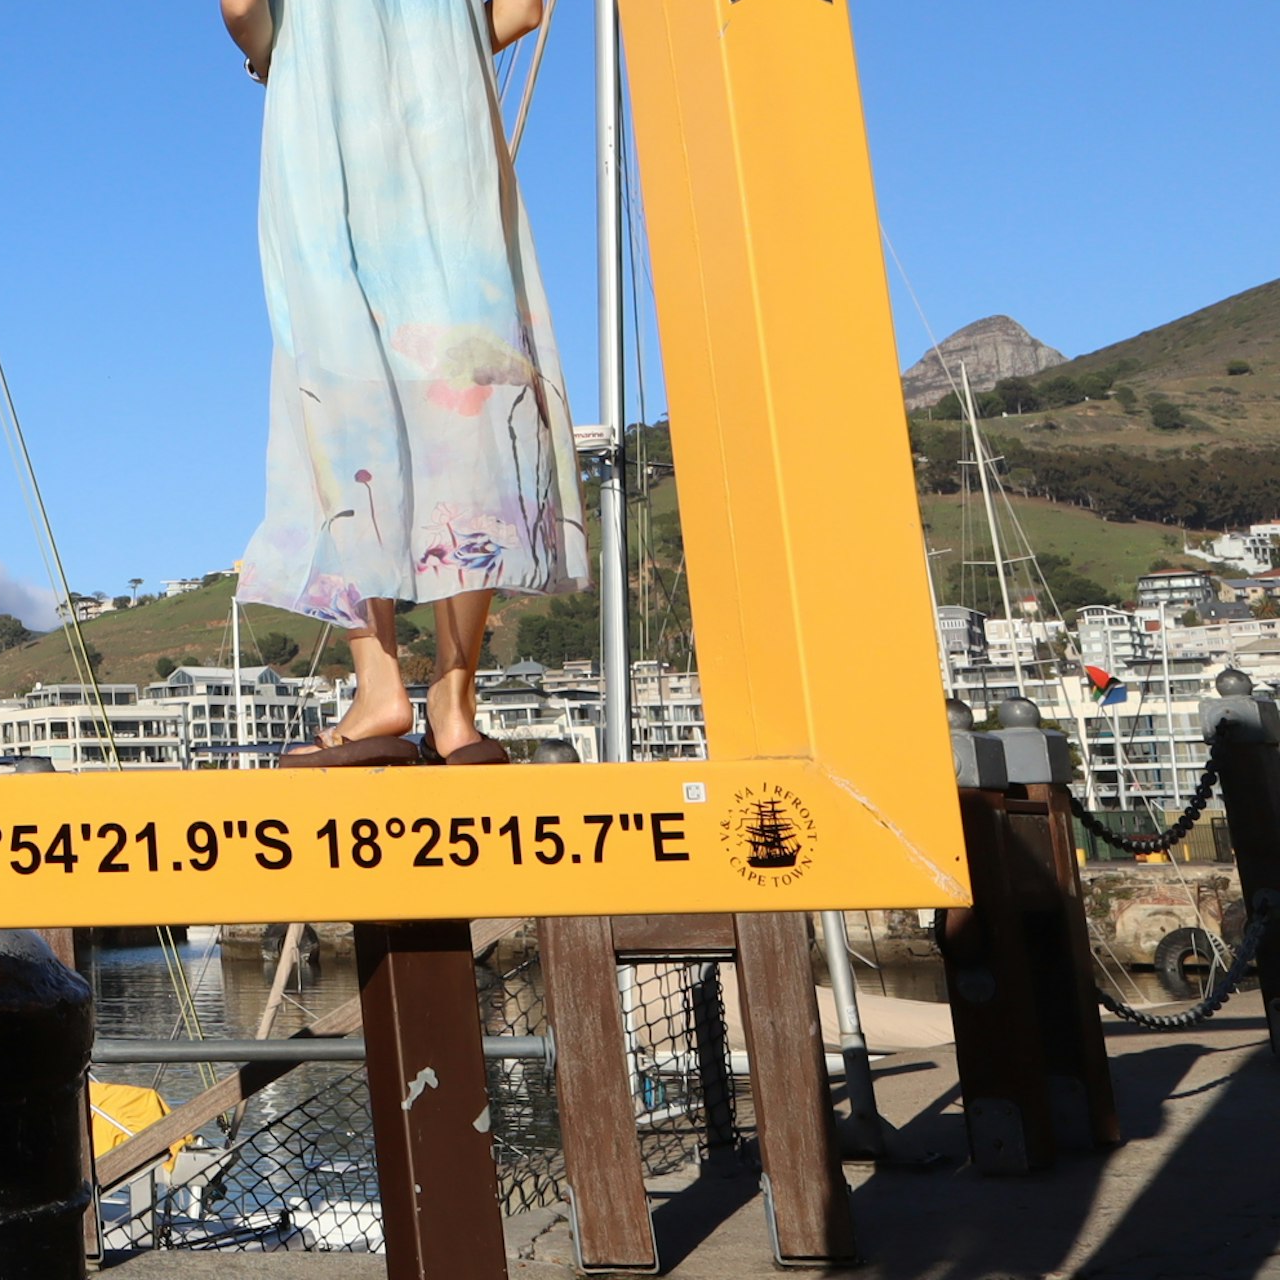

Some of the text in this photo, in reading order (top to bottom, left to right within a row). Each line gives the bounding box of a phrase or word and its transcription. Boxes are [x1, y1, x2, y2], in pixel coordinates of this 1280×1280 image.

[316, 812, 690, 869] 18°25'15.7"E
[730, 855, 813, 888] CAPE TOWN
